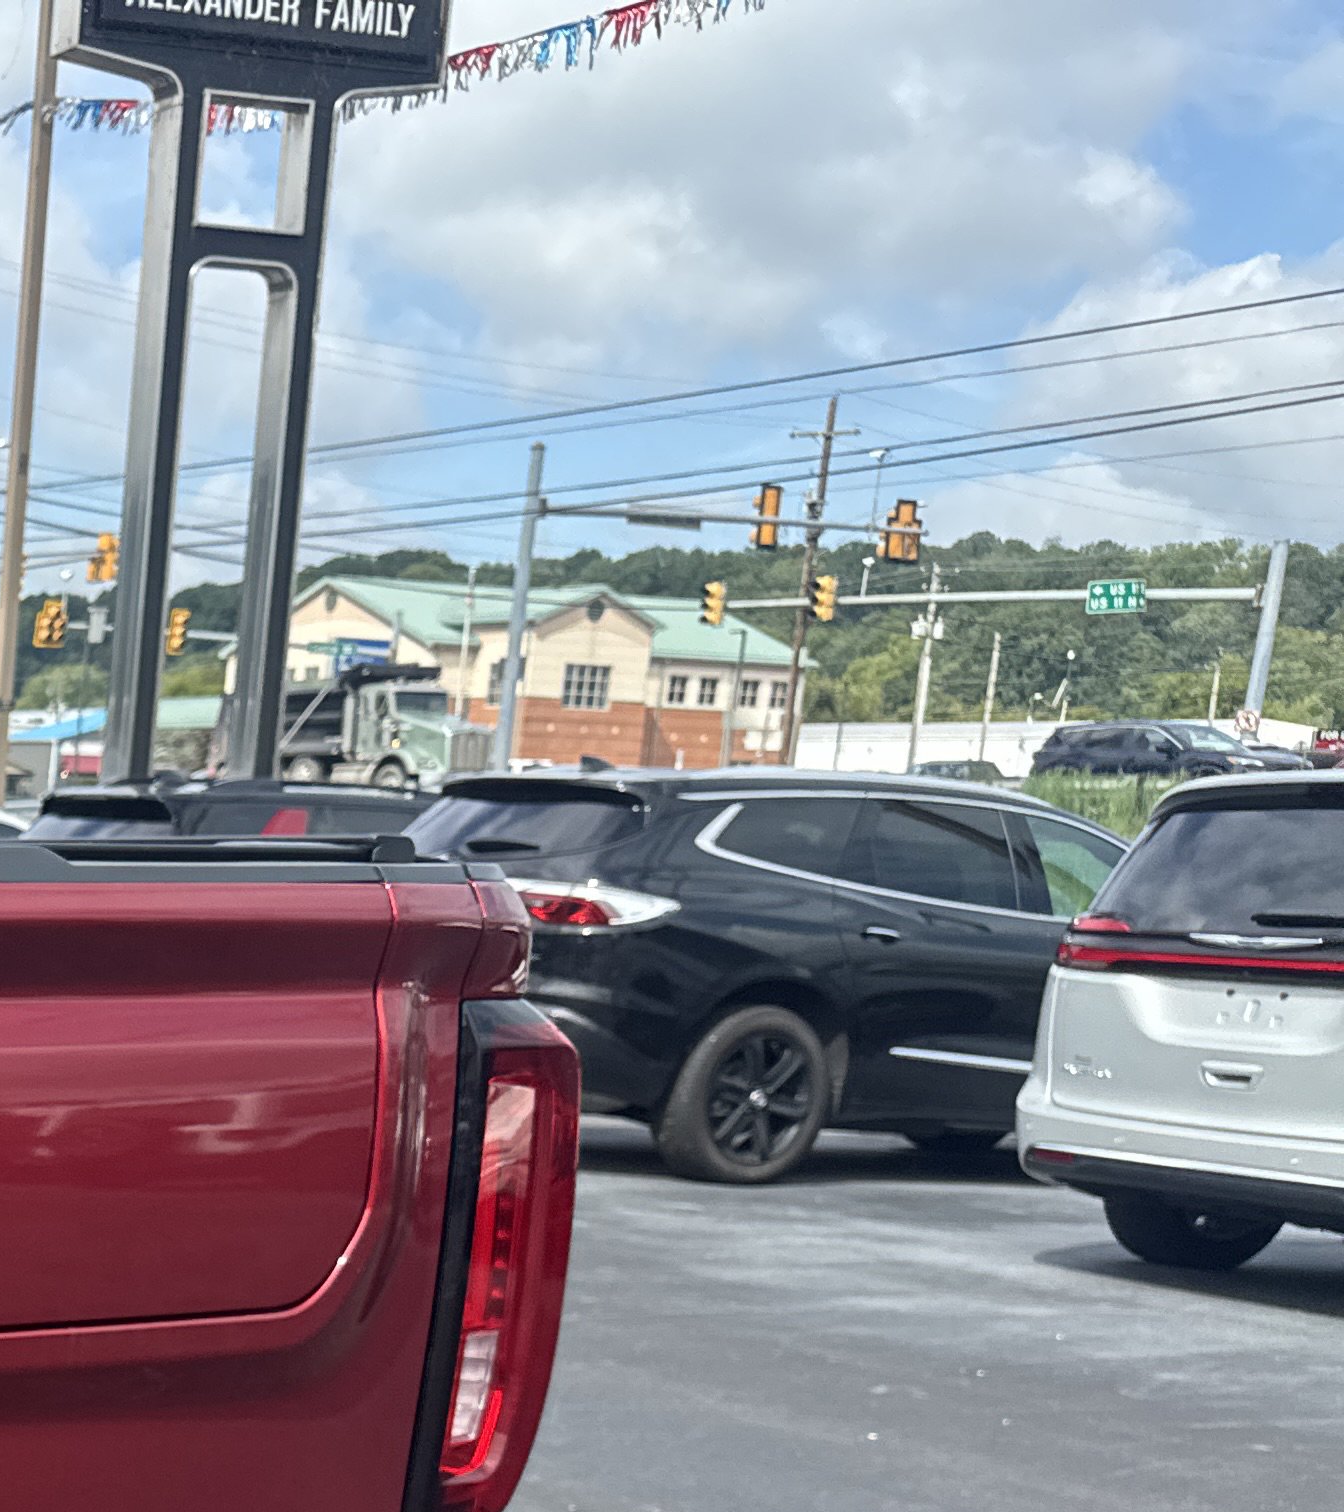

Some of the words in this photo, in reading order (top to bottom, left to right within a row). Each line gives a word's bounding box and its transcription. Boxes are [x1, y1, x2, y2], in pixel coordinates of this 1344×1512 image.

[125, 0, 300, 27] XANDER
[314, 2, 415, 38] FAMILY
[1110, 583, 1126, 596] US
[1090, 597, 1108, 610] US
